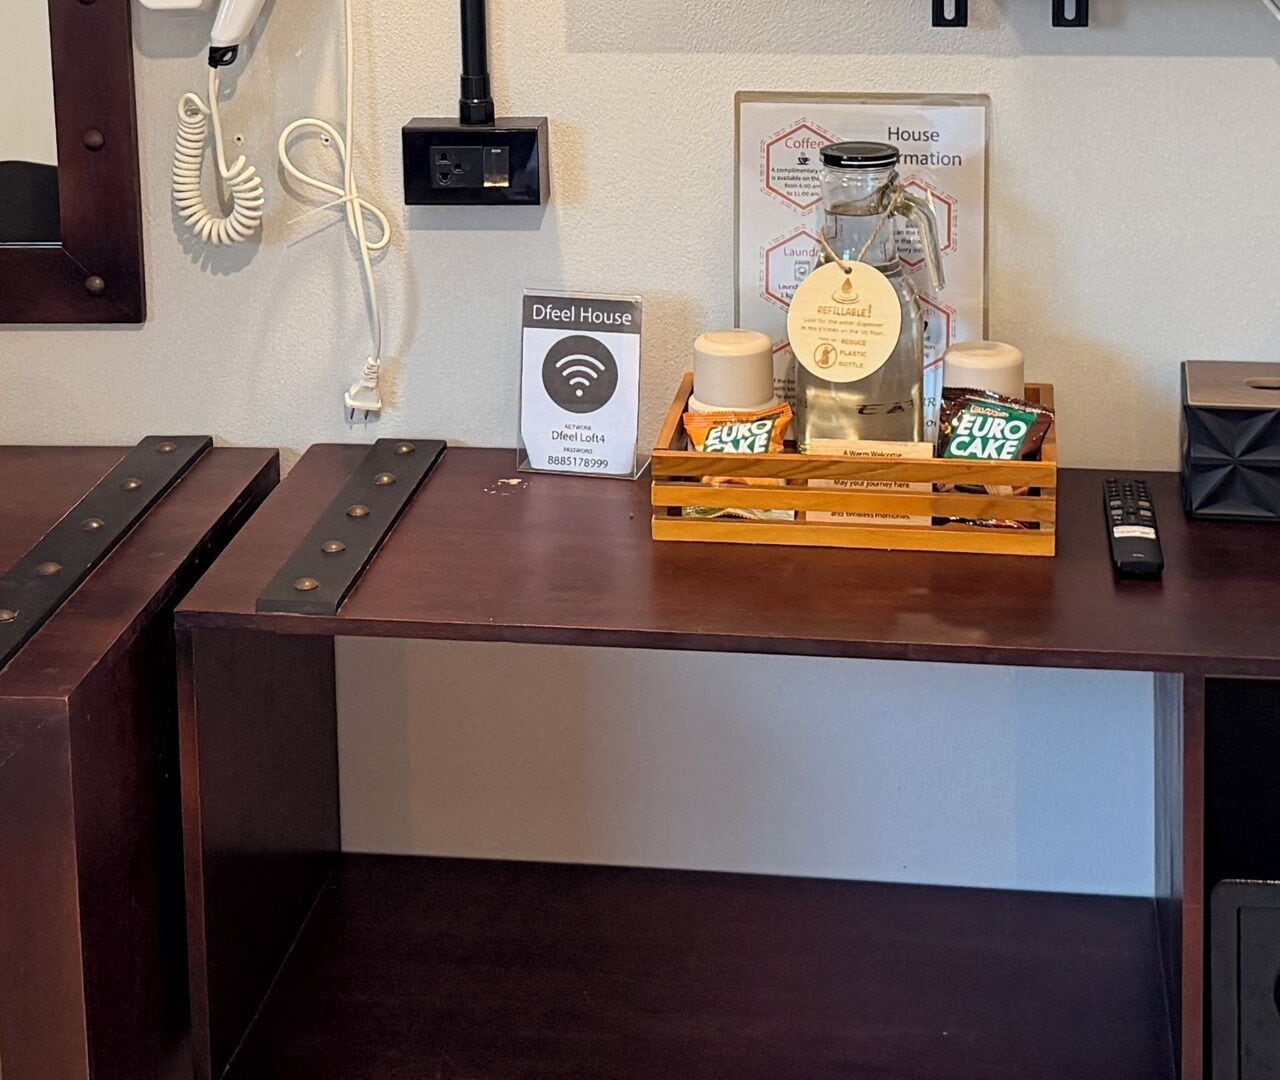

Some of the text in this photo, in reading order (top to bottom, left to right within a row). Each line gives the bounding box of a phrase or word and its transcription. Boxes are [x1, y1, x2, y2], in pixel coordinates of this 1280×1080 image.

[887, 126, 940, 142] House
[784, 137, 824, 149] Coffee
[897, 151, 962, 167] rmation
[783, 246, 819, 257] Laundr
[532, 304, 632, 325] Dfeel House
[705, 419, 774, 445] EURO
[956, 413, 1028, 440] EURO
[551, 430, 578, 442] Dfeel
[950, 435, 1019, 460] CAKE
[547, 455, 609, 469] 8885178999
